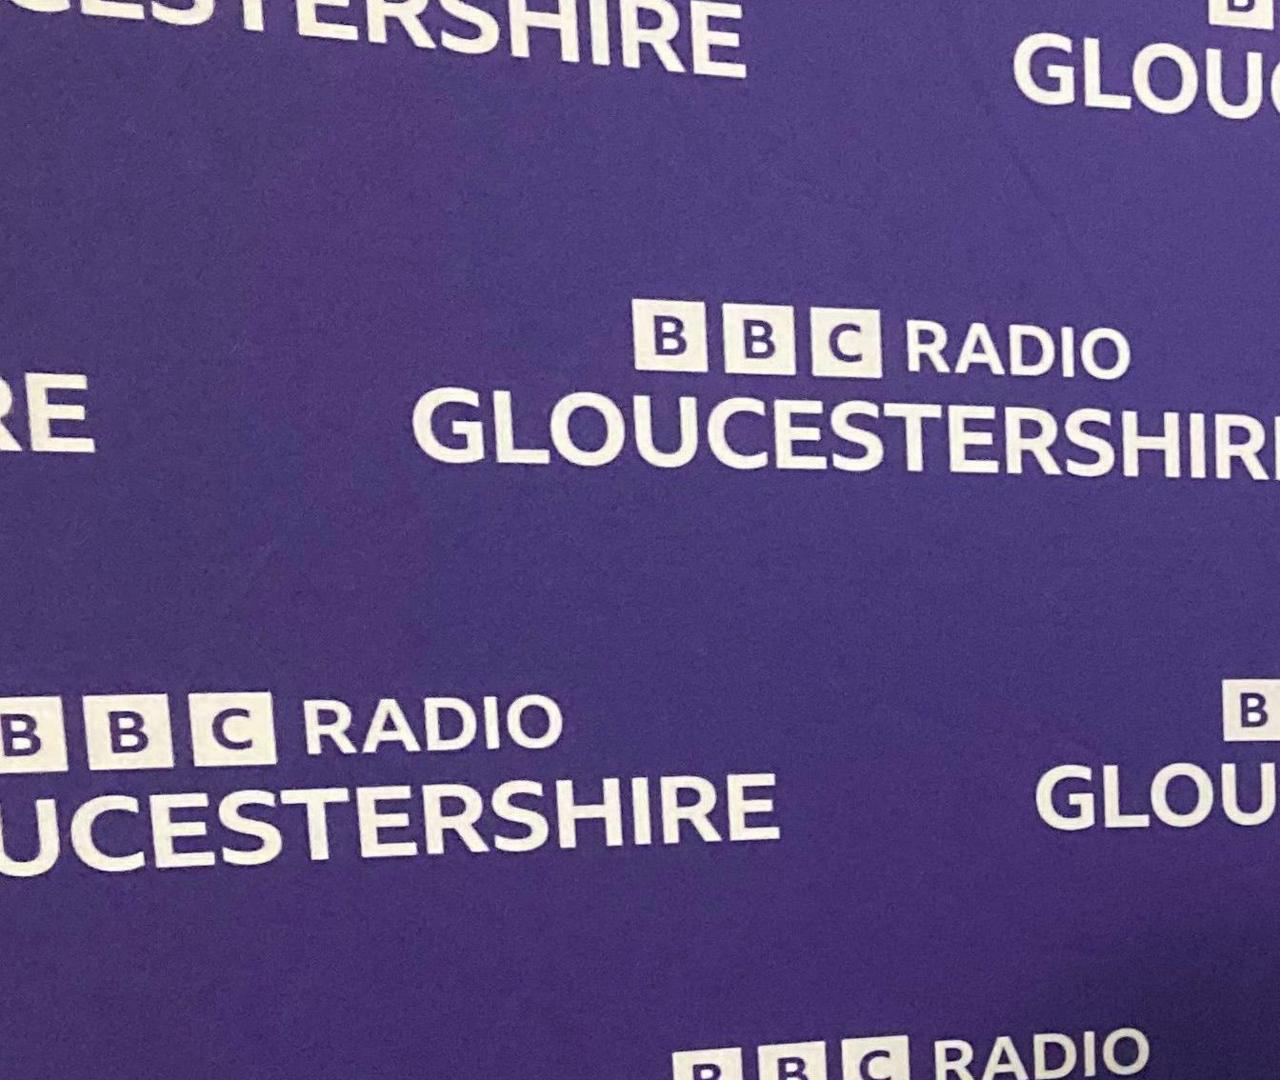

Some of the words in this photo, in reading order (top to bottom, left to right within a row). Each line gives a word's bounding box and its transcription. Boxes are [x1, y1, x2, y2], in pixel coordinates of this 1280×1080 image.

[650, 312, 866, 366] BBC
[907, 319, 1130, 380] RADIO
[0, 704, 256, 760] BBC
[303, 696, 563, 755] RADIO
